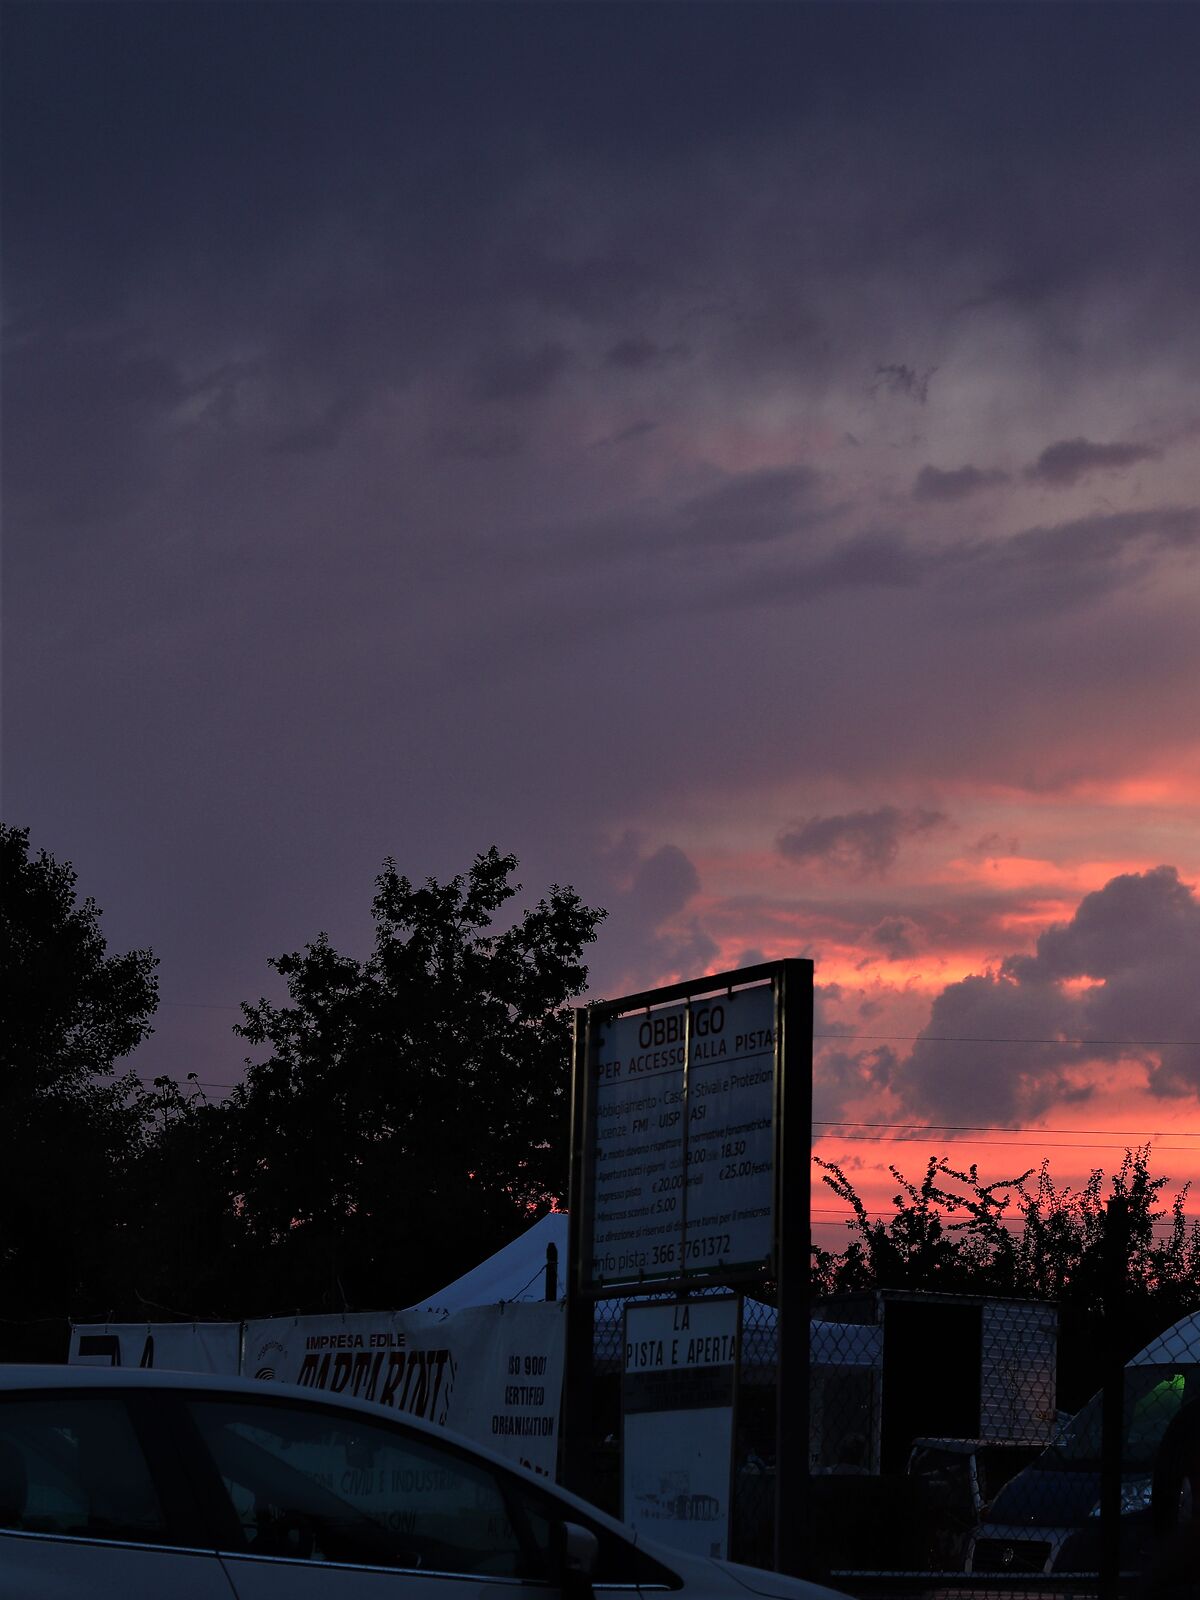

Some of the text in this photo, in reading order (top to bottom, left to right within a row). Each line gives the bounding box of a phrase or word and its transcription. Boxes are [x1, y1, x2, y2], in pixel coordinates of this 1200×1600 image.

[628, 1047, 685, 1074] ACCESSO
[694, 1039, 727, 1060] ALLA
[735, 1029, 773, 1052] PISTA
[658, 1111, 681, 1129] UISP
[690, 1104, 706, 1121] ASI
[721, 1140, 746, 1159] 18.30
[652, 1243, 675, 1265] 366
[673, 1305, 690, 1331] LA
[306, 1333, 406, 1350] IMPRESA EDILE
[626, 1335, 736, 1368] PISTA E APERTA
[508, 1355, 547, 1376] ISO 9001
[505, 1385, 545, 1406] CERTIFIED
[492, 1415, 554, 1436] ORGANISATION
